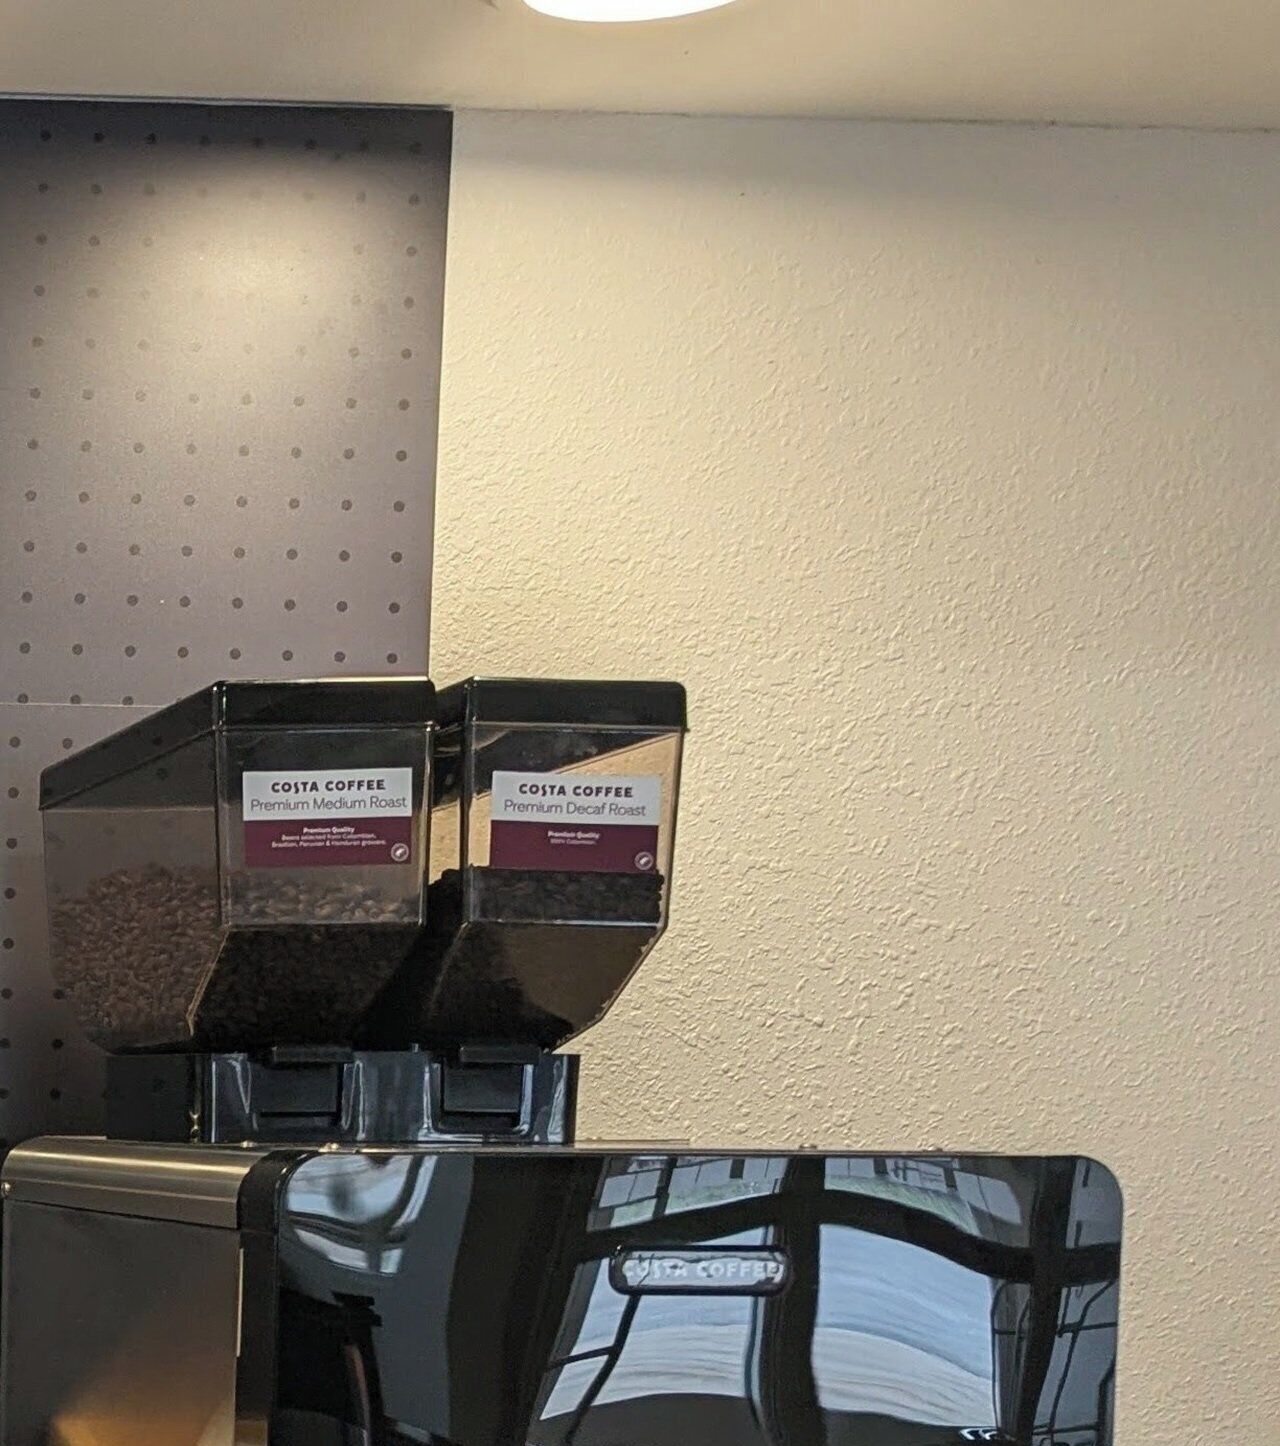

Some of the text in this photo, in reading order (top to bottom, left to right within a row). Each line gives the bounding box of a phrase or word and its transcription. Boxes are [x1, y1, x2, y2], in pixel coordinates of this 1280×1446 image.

[271, 778, 386, 794] COSTA COFFEE
[519, 783, 633, 798] COSTA COFFEE
[250, 795, 407, 812] Premium Medium Roast
[504, 799, 646, 816] Premium Decaf Roast
[623, 1259, 780, 1279] COSTA COFFEE
